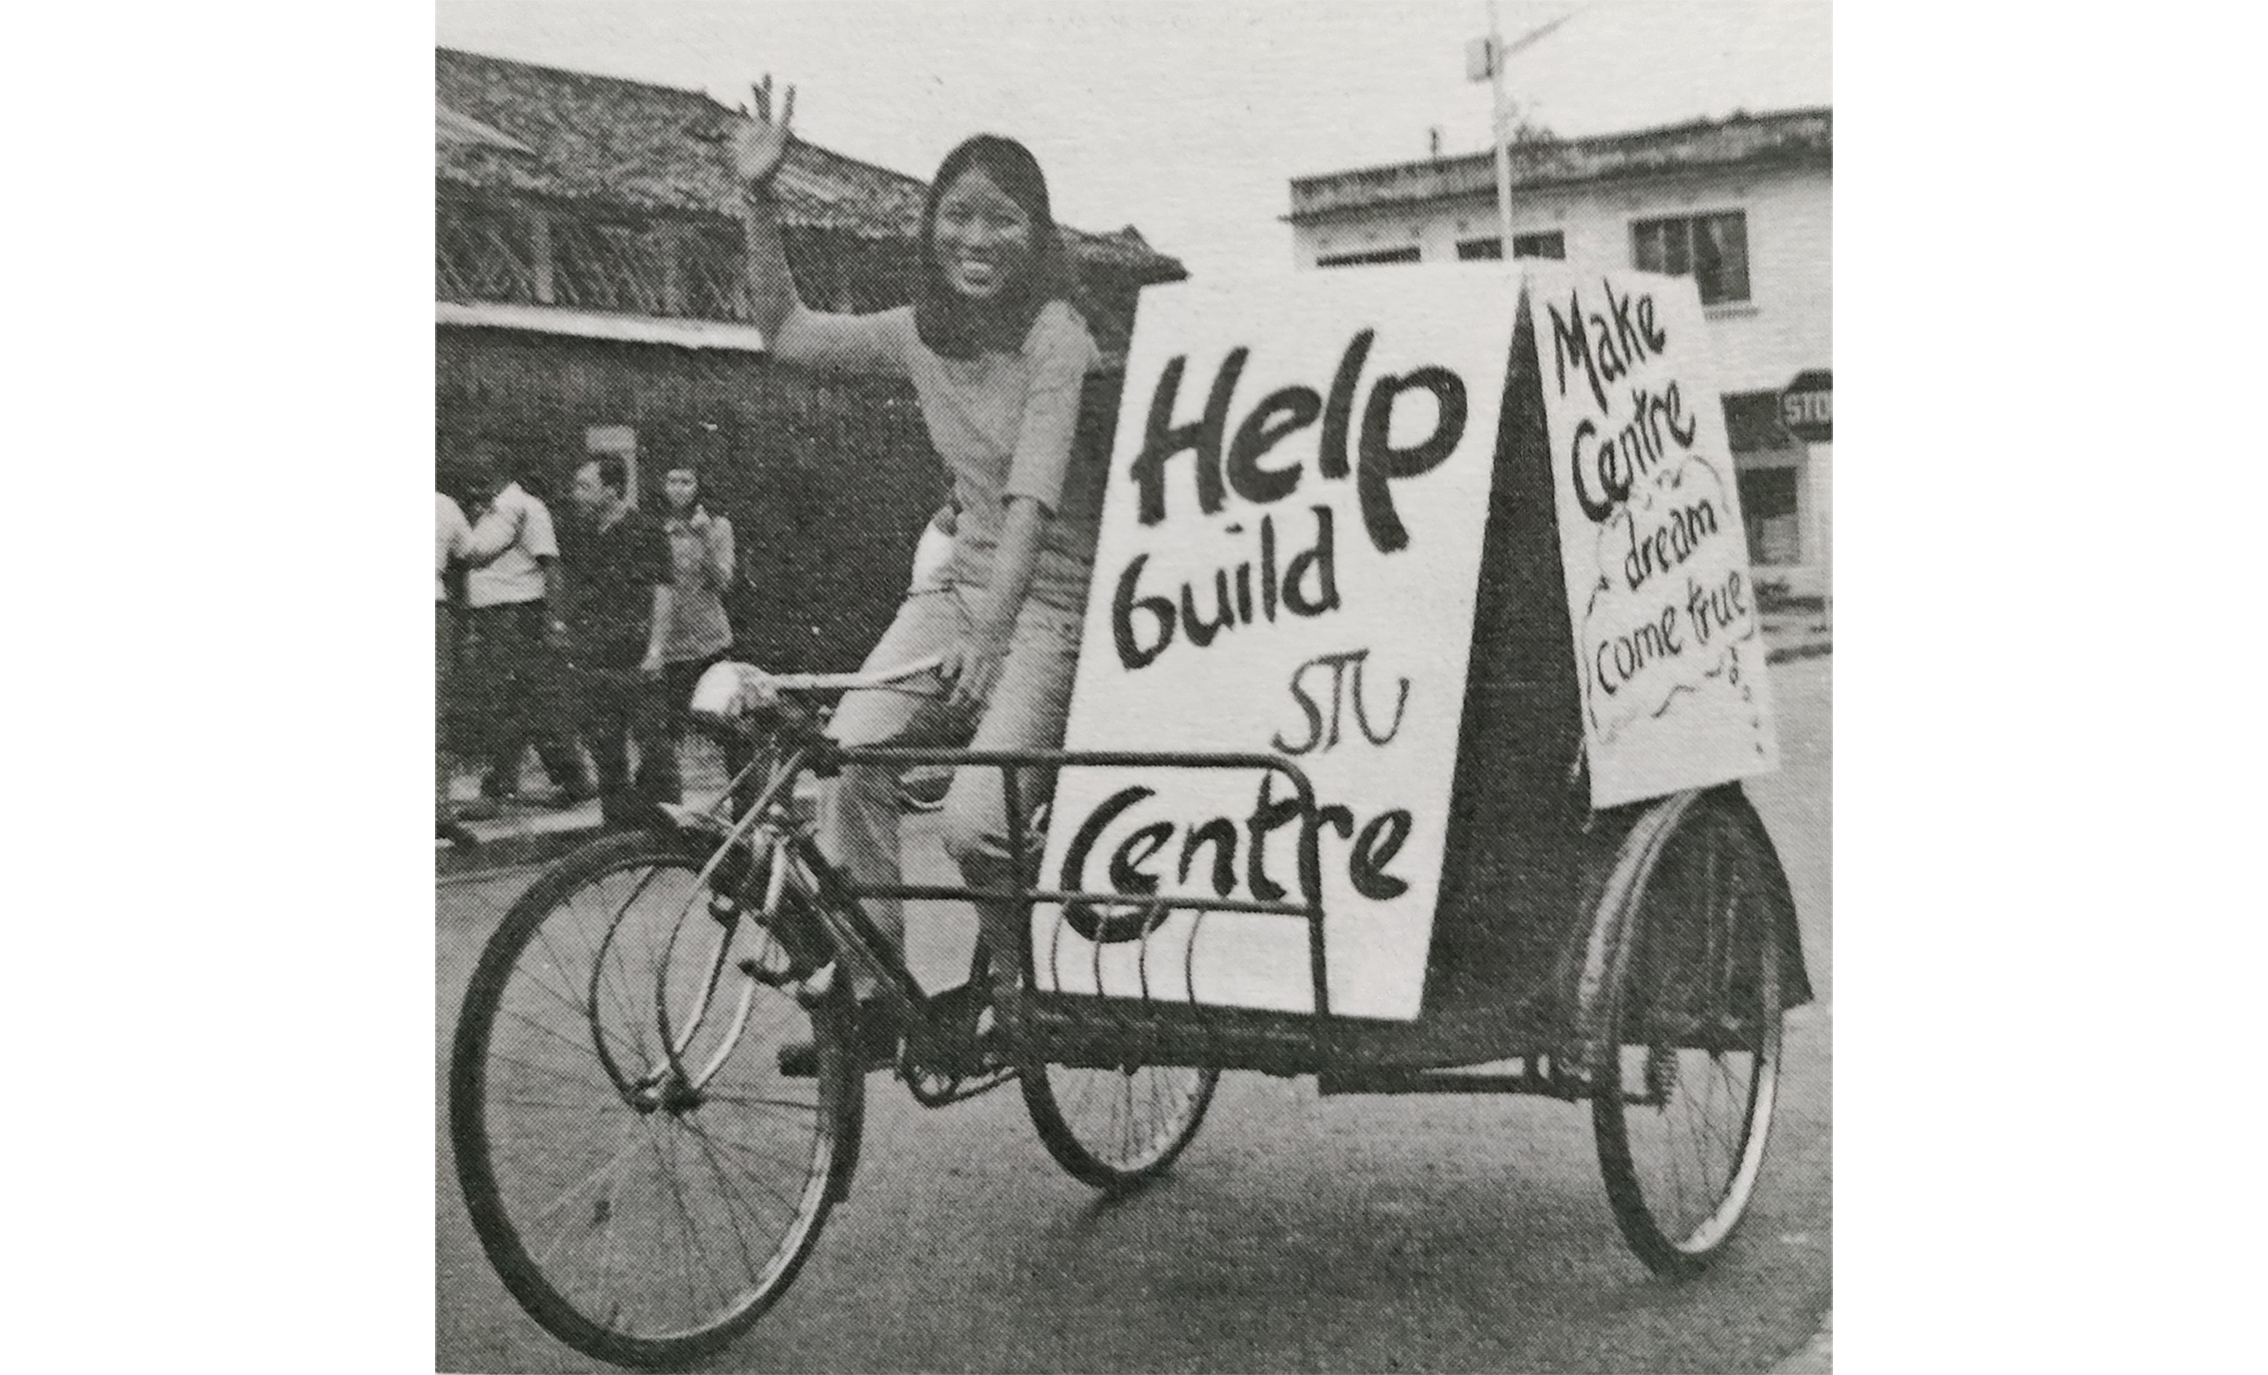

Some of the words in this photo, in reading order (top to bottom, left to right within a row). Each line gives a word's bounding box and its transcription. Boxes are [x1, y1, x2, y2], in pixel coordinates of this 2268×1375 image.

[1547, 277, 1667, 415] Make
[1131, 328, 1468, 554] Help
[1571, 379, 1697, 522] Centre
[1112, 505, 1341, 672] build
[1624, 499, 1719, 592] dream
[1271, 648, 1410, 755] STU
[1597, 606, 1683, 696] come
[1060, 768, 1412, 944] Centre
